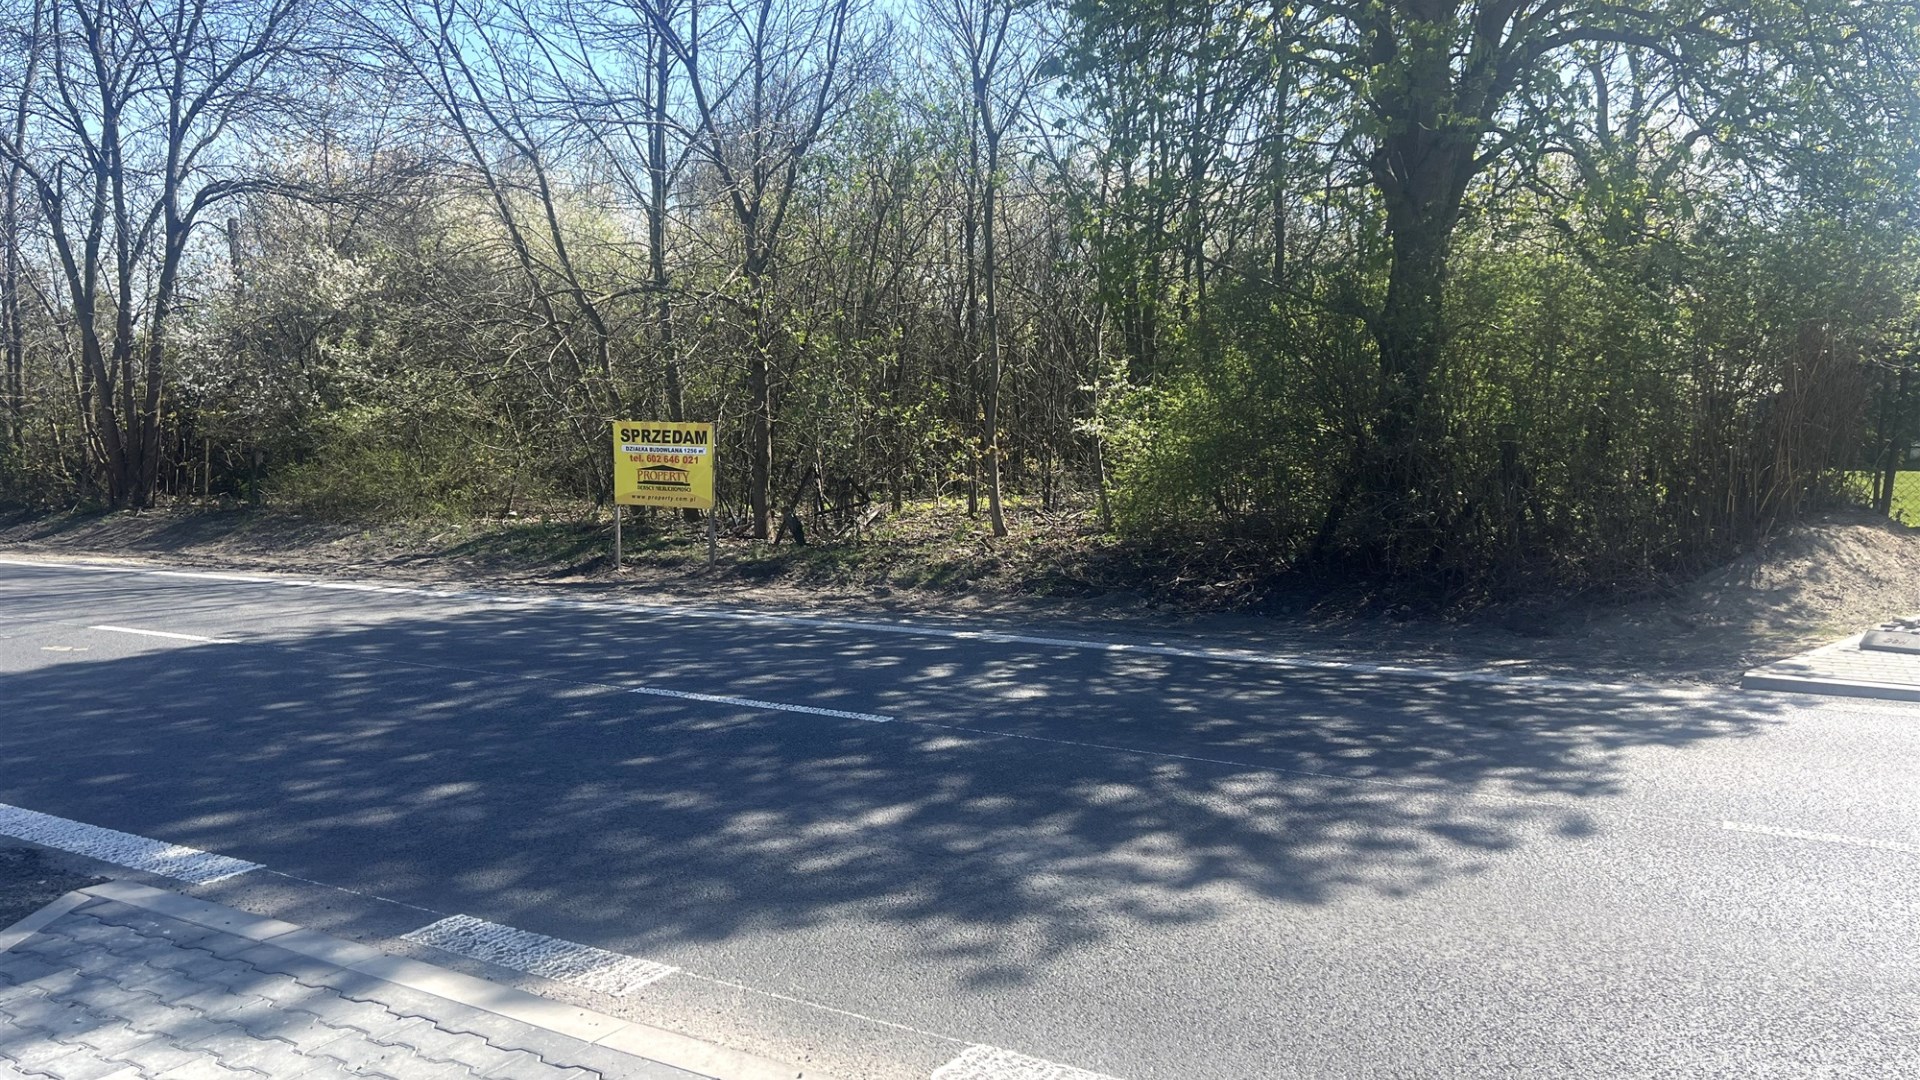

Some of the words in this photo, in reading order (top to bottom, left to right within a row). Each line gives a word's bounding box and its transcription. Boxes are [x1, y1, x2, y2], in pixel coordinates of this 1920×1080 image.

[621, 428, 707, 444] SPRZEDAM
[646, 455, 661, 463] 602
[663, 455, 680, 464] 646
[682, 456, 699, 464] 021
[637, 470, 689, 482] PROPERTY
